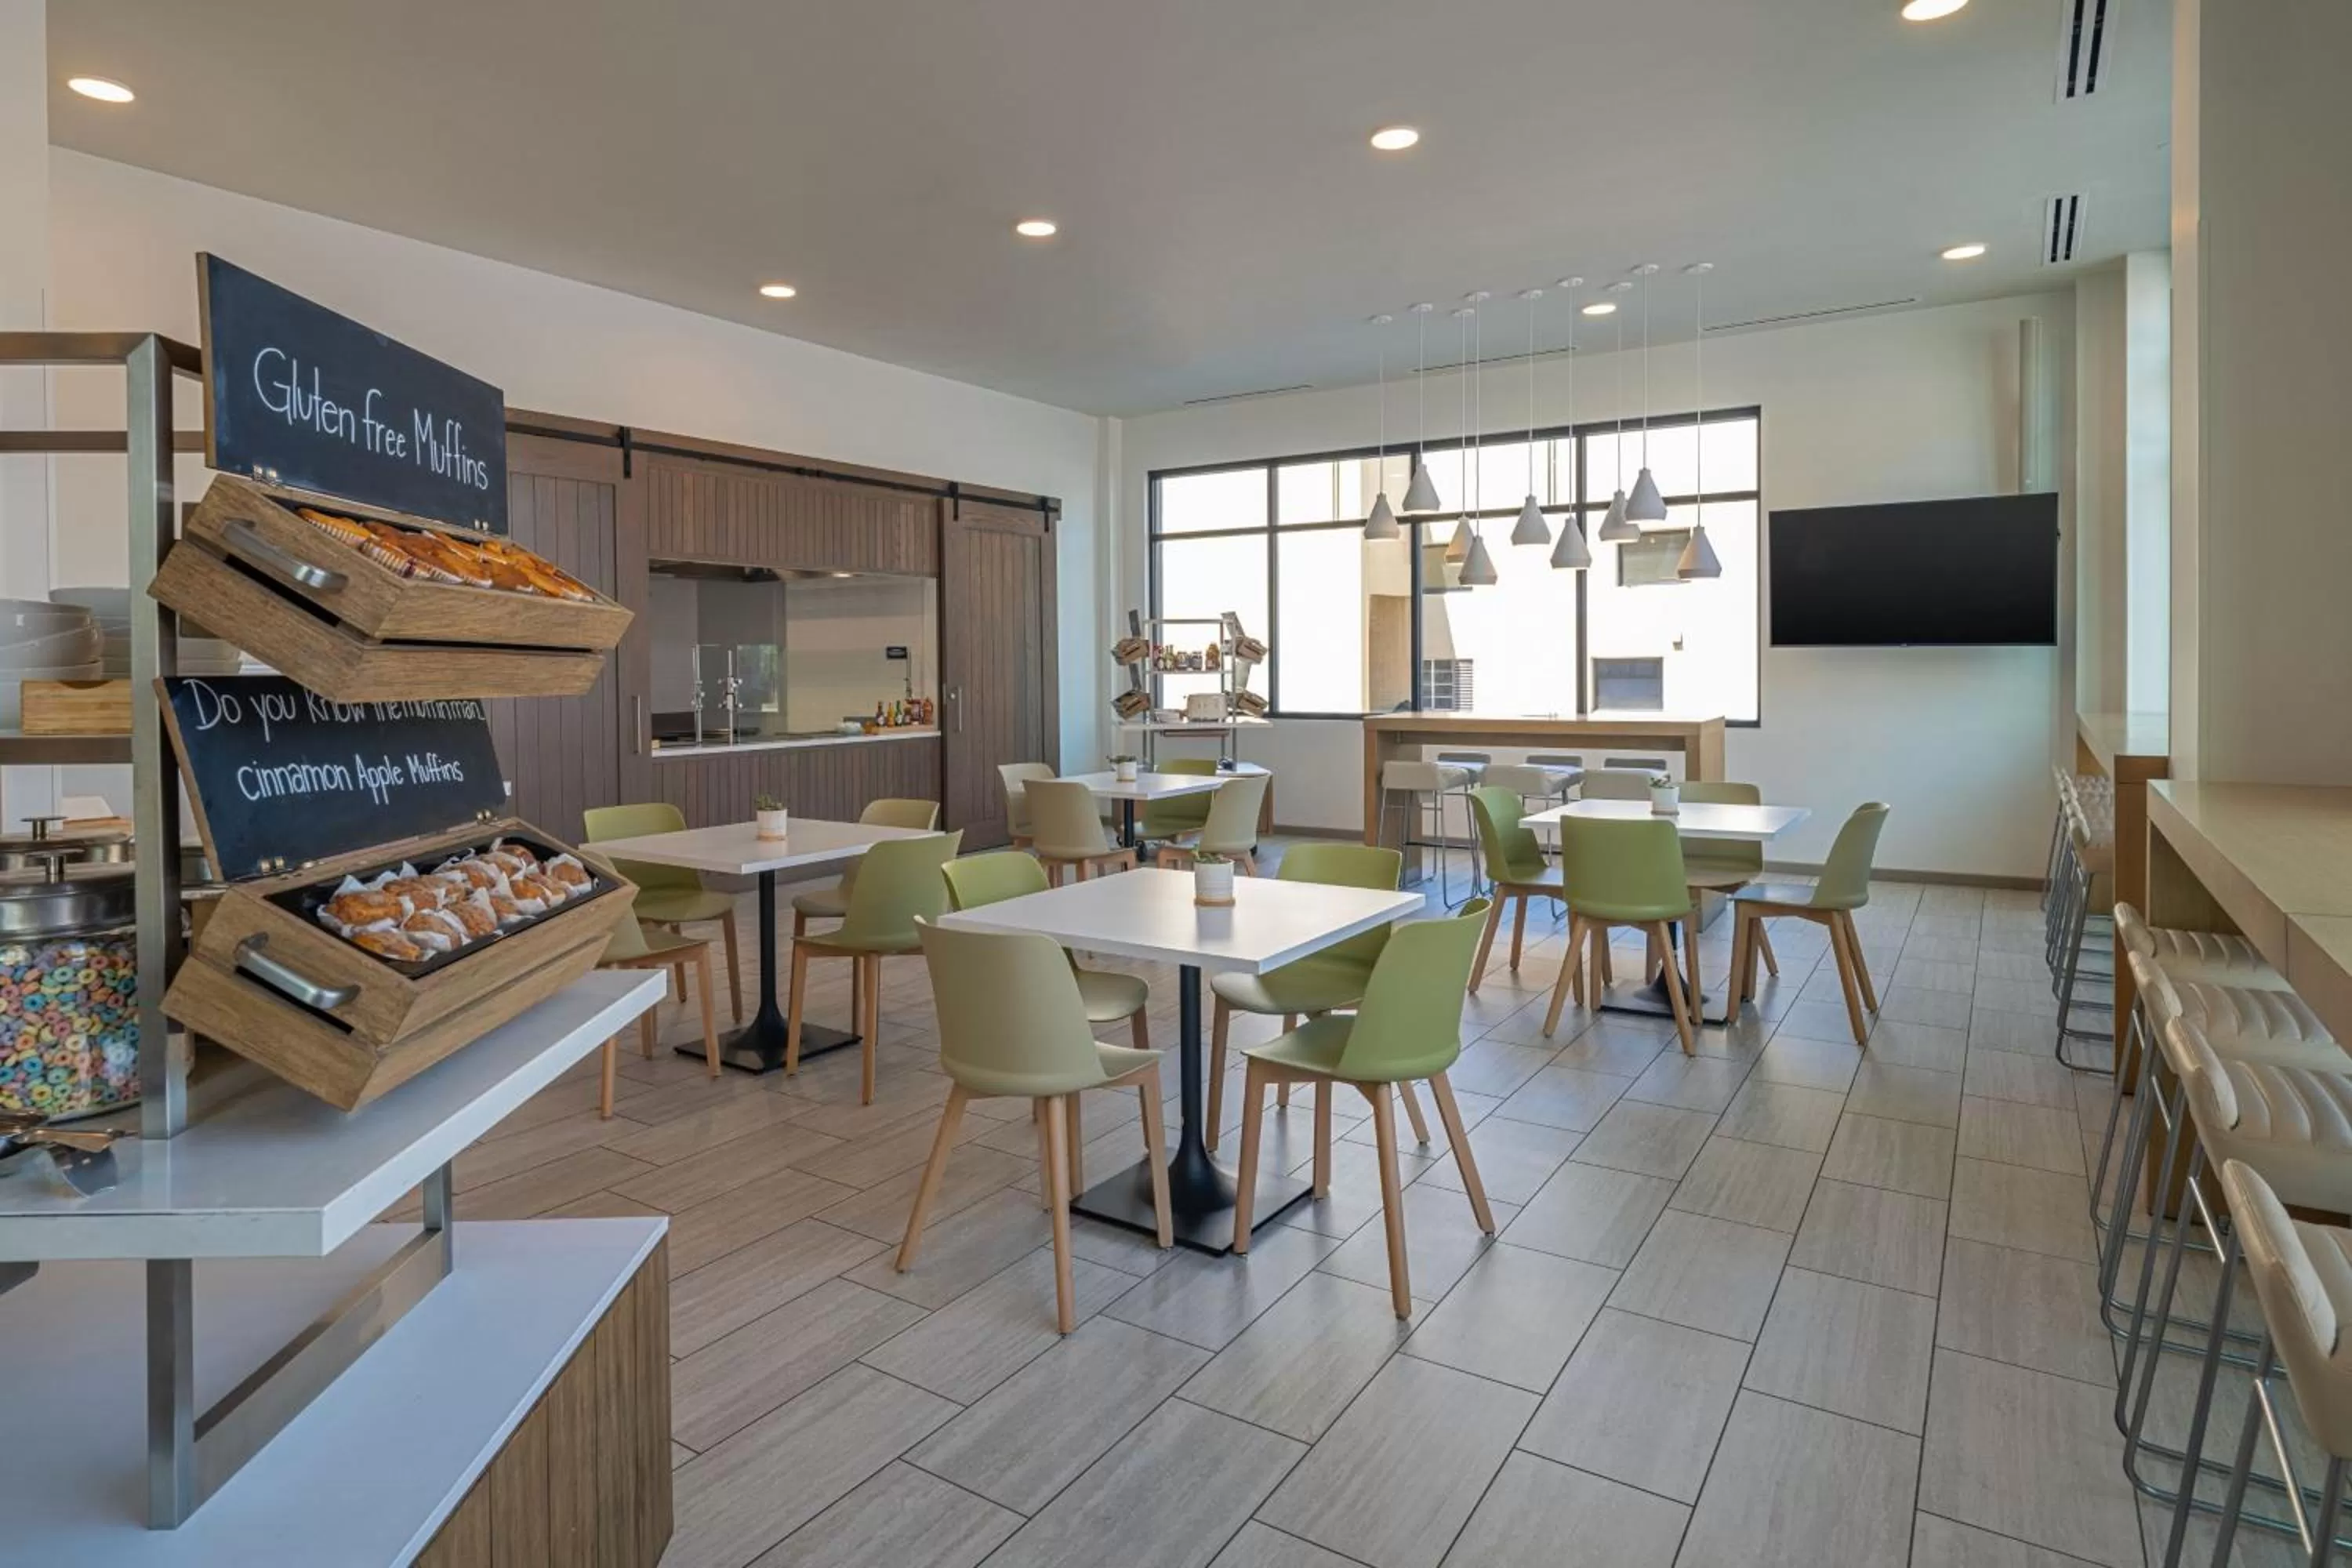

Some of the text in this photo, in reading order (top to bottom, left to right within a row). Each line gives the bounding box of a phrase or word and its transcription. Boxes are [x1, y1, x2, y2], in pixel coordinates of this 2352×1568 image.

[253, 347, 489, 490] Gluten free Muffins
[182, 678, 242, 731] Do
[249, 693, 296, 742] you
[354, 753, 405, 805] Apple
[406, 752, 464, 785] Muffins
